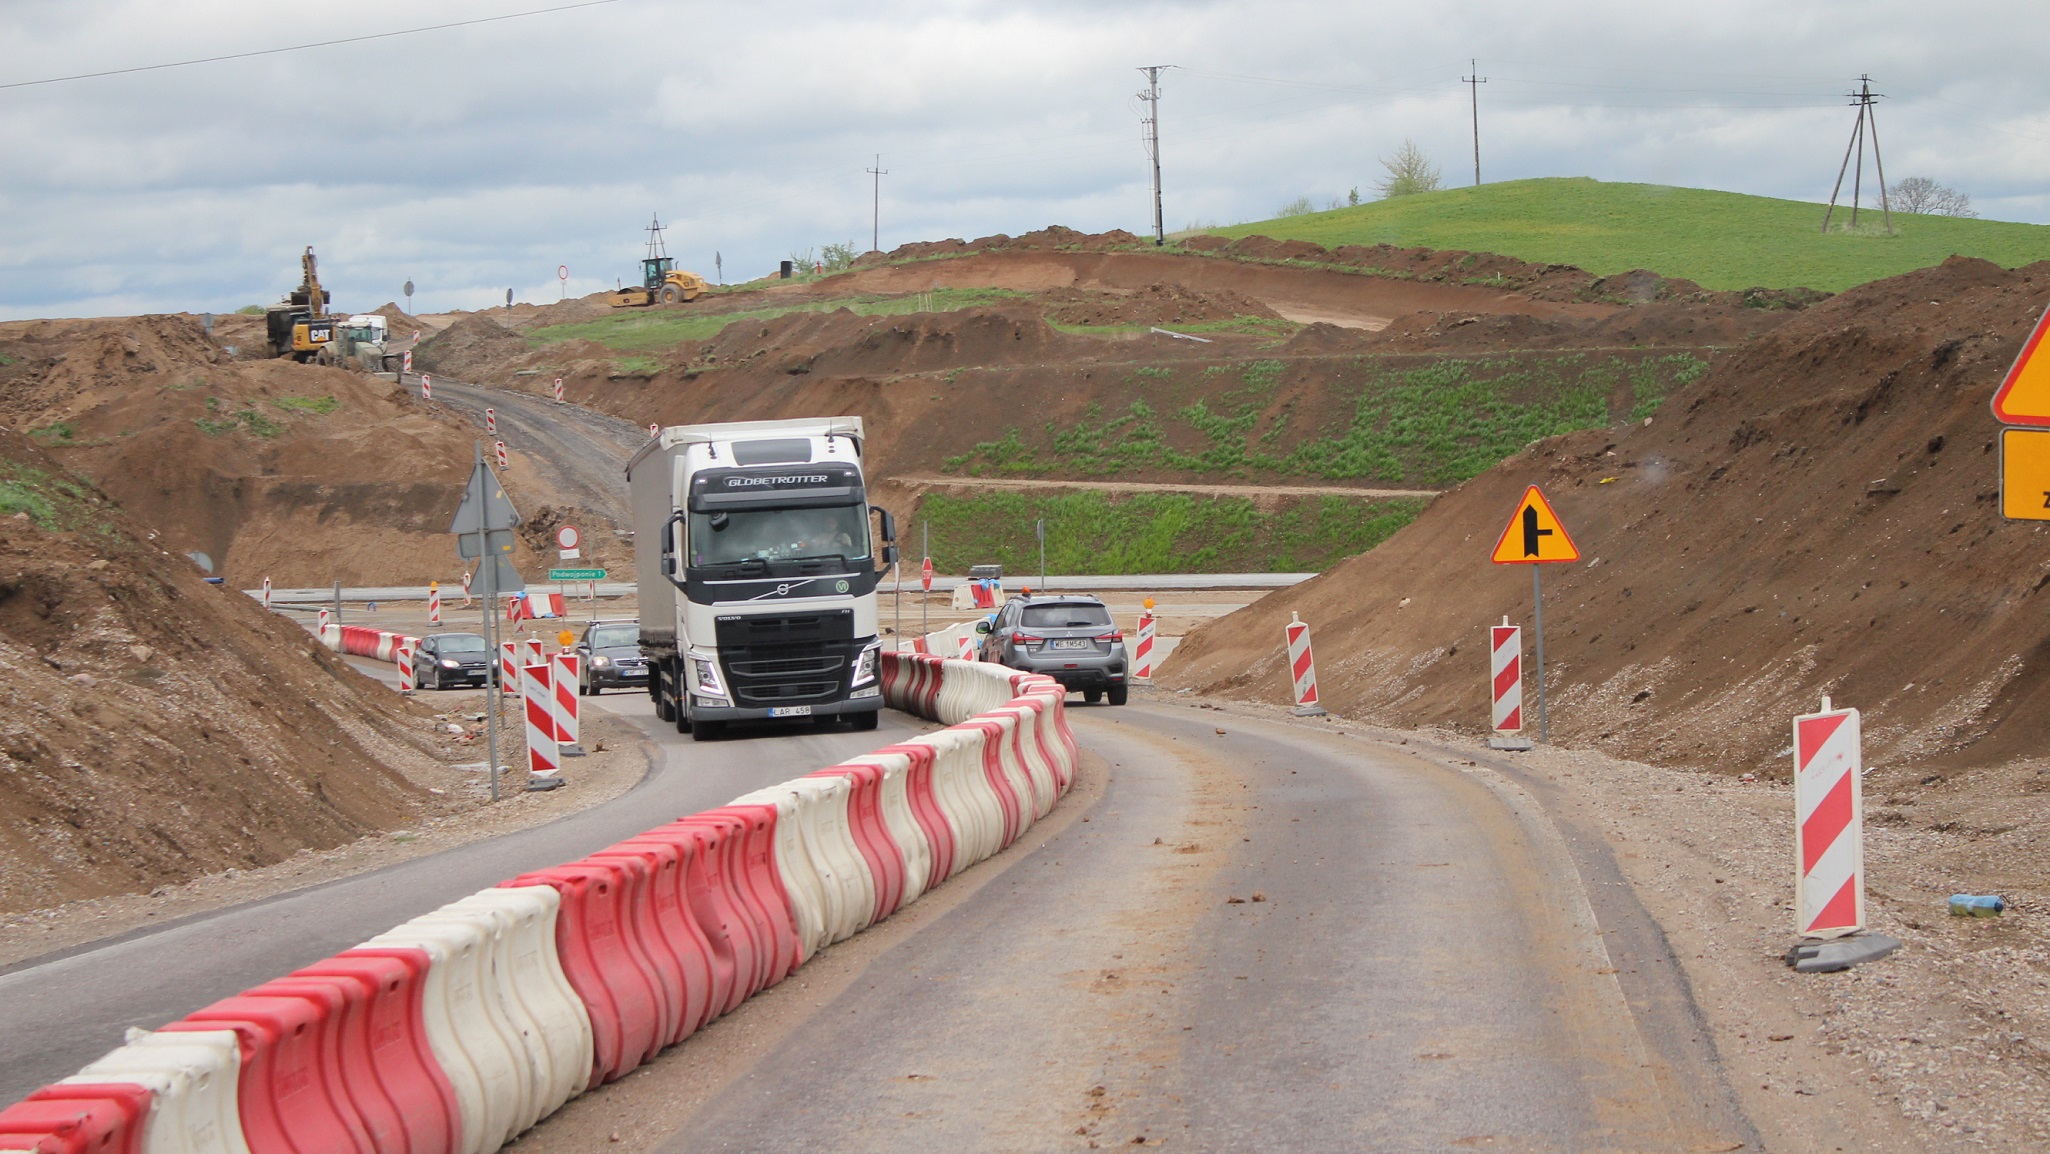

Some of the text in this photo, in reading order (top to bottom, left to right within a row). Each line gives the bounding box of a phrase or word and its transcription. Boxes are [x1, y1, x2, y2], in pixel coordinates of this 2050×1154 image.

[311, 329, 331, 342] CAT
[728, 475, 828, 487] GLOBETROTTER
[552, 570, 596, 579] Podwojponie
[773, 706, 811, 716] LAR 458
